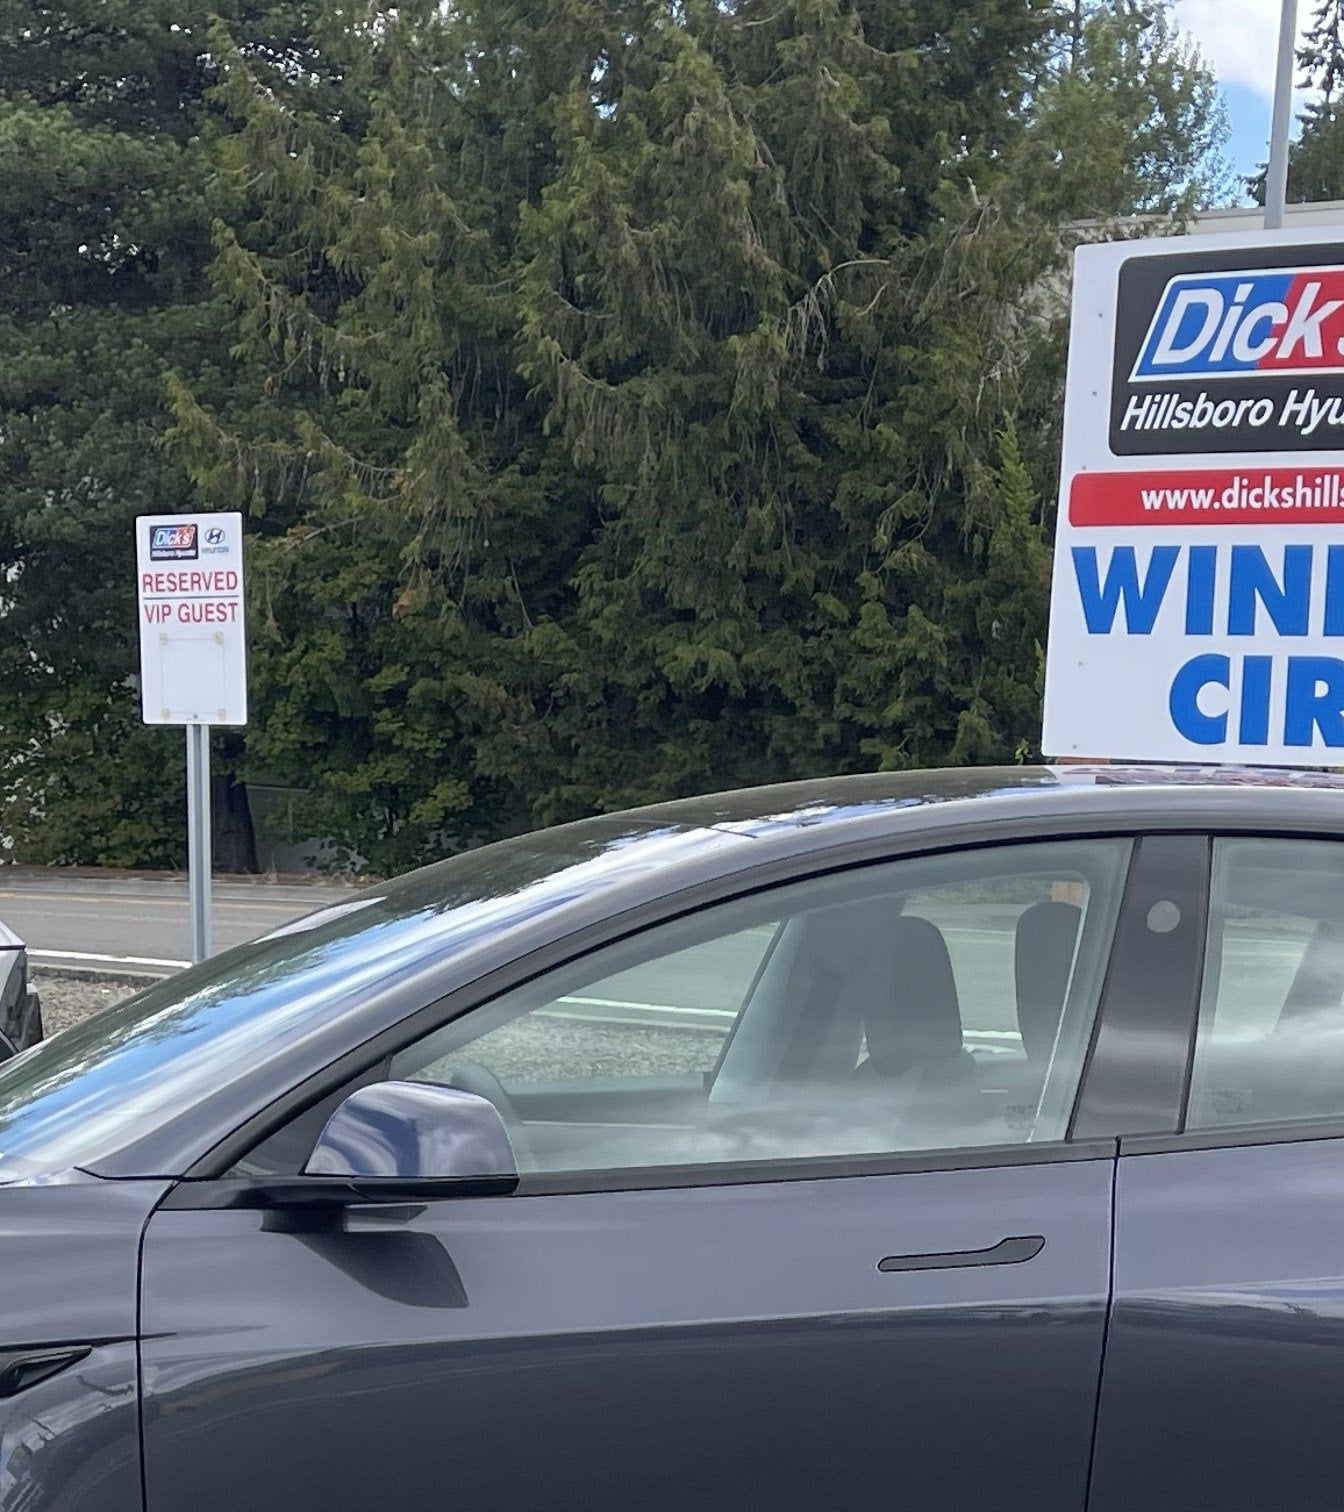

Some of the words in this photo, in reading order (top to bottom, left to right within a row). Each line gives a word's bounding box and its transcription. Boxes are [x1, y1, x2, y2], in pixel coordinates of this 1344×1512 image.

[1119, 391, 1274, 431] Hillsboro
[142, 571, 238, 593] RESERVED
[144, 604, 171, 624] VIP
[178, 602, 239, 623] GUEST
